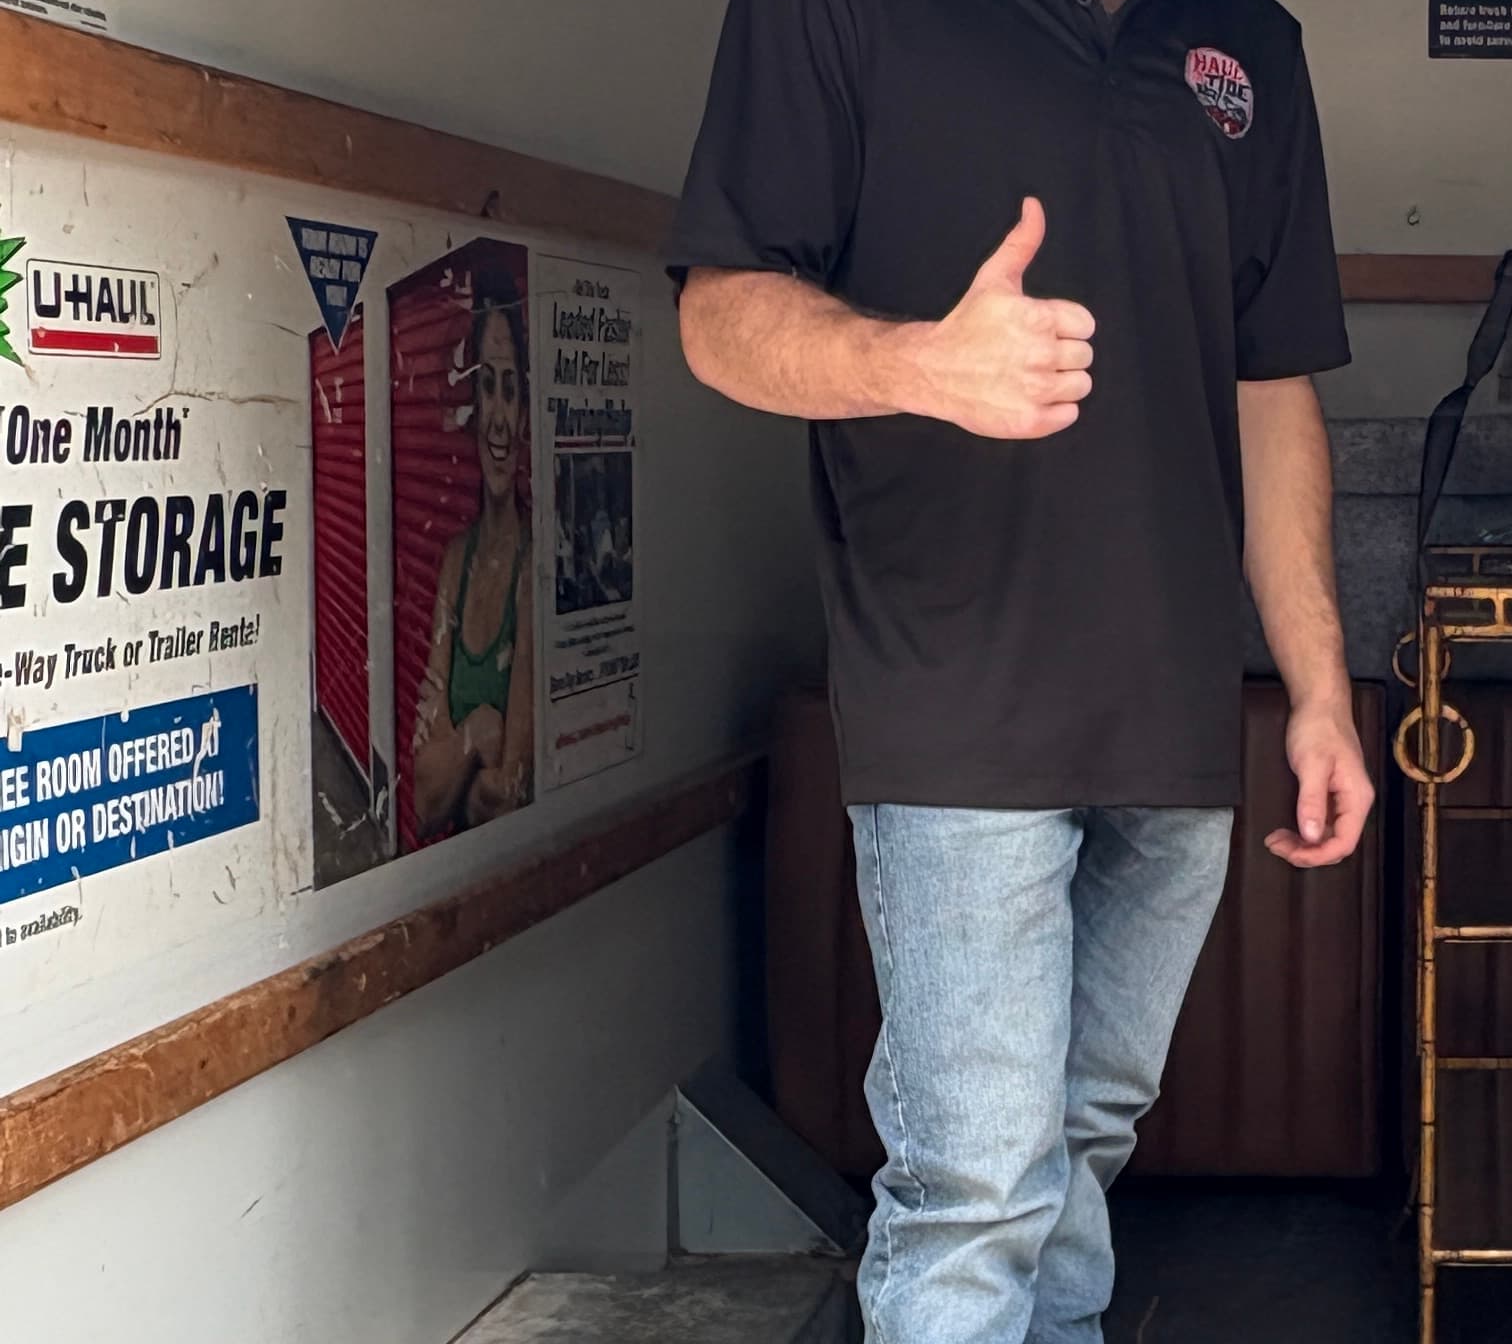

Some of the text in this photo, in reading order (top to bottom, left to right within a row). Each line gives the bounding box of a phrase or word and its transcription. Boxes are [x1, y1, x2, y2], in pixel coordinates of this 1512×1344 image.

[1194, 52, 1244, 80] HAUL
[33, 269, 156, 325] U-HAUL
[6, 404, 72, 465] One
[52, 489, 287, 604] STORAGE
[64, 637, 117, 679] Truck
[123, 639, 144, 667] or
[148, 626, 204, 663] Trailer
[36, 748, 102, 803] ROOM
[108, 728, 193, 782] OFFERED
[0, 770, 225, 873] IGIN OR DESTINATION!
